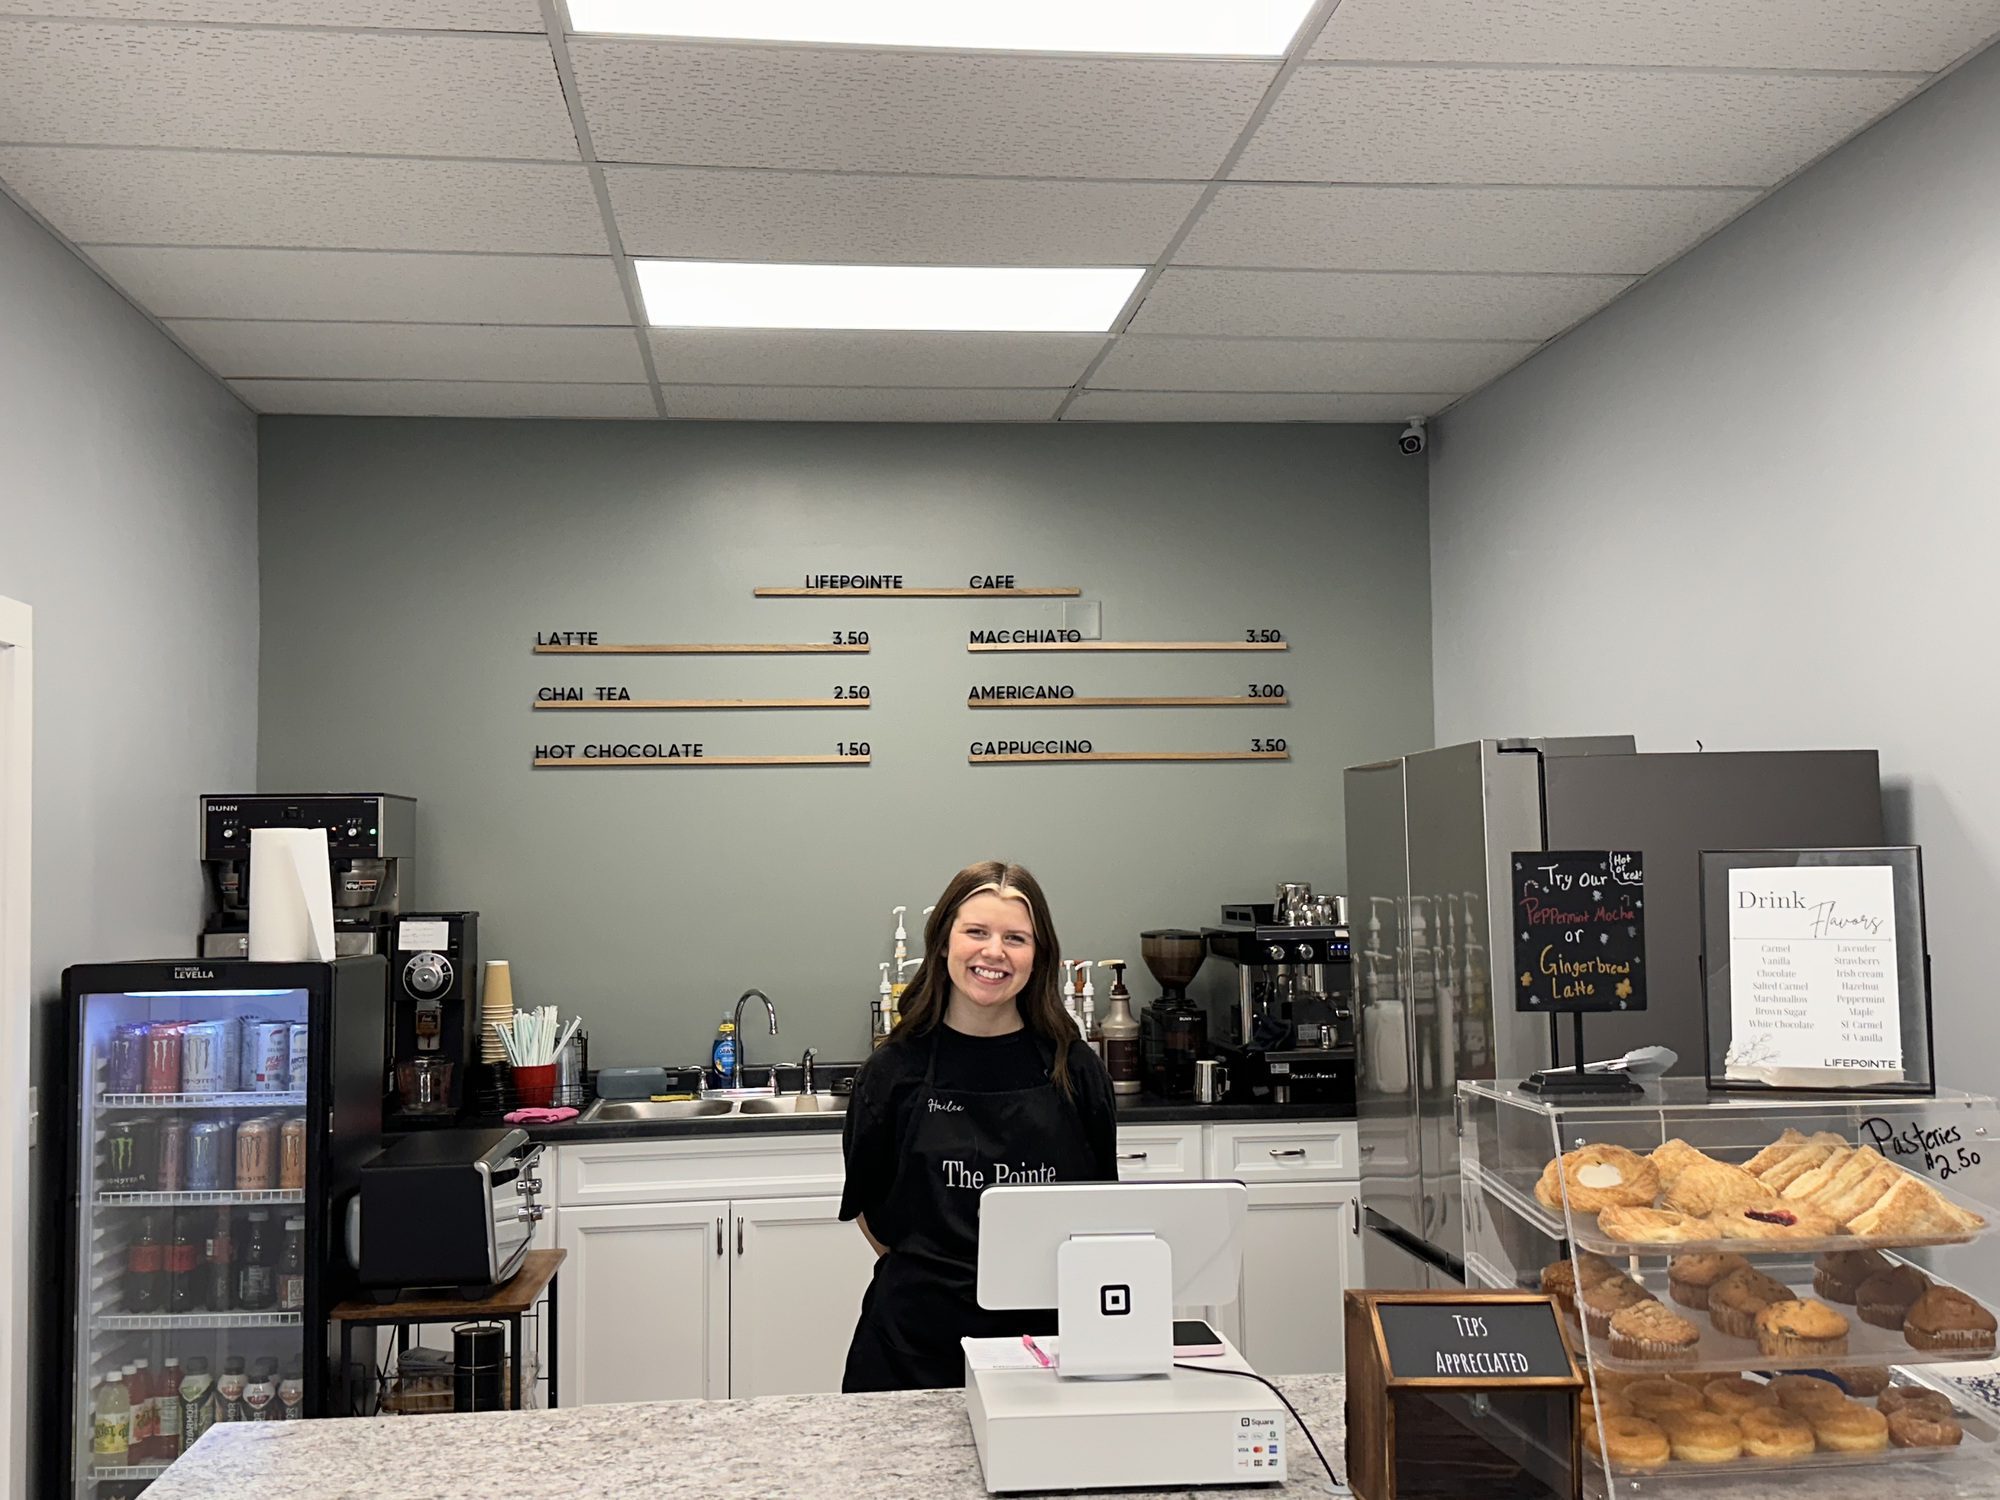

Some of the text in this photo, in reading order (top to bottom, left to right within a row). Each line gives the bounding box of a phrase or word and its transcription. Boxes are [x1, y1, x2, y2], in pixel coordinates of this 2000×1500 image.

[805, 574, 1015, 590] LIFEPOINTE CAFE
[537, 631, 870, 646] LATTE 3.50
[969, 629, 1281, 644] MACCHIATO 3.50
[537, 685, 871, 701] CHAI TEA 2.50
[968, 684, 1285, 700] AMERICANO 3.00
[535, 742, 871, 759] HOT CHOCOLATE 1.50
[970, 738, 1287, 756] CAPPUCCINO 3.50
[1613, 854, 1632, 865] Hot
[1616, 865, 1626, 874] or
[1537, 864, 1573, 891] Try
[1738, 891, 1806, 909] Drink
[1593, 906, 1636, 922] Mocha
[1808, 901, 1884, 939] Flavors
[1564, 928, 1585, 943] or
[1761, 944, 1791, 953] Carmel
[1837, 944, 1876, 953] Lavender
[1540, 944, 1630, 977] Gingerbread
[1761, 957, 1791, 965] Vanilla
[1834, 957, 1881, 966] Strawberry
[174, 970, 214, 978] LEVELLA
[1756, 969, 1796, 978] Chocolate
[1836, 969, 1856, 978] Irish
[1552, 977, 1595, 998] Latte
[1752, 982, 1808, 990] Salted Carmel
[1841, 982, 1879, 990] Hazelnut
[1753, 994, 1808, 1003] Marshmallow
[1836, 994, 1885, 1004] Peppermint
[1755, 1007, 1807, 1017] Brown Sugar
[1849, 1007, 1874, 1017] Maple
[1749, 1020, 1815, 1029] White Chocolate
[1852, 1020, 1883, 1029] Carmel
[1853, 1033, 1883, 1042] Vanilla
[1824, 1058, 1896, 1069] LIFEPOINTE
[1860, 1117, 1962, 1157] Pasteries
[942, 1160, 1056, 1189] The Pointe
[1451, 1314, 1489, 1338] TIPS
[1435, 1350, 1529, 1374] APPRECIATED
[1251, 1418, 1275, 1426] Square
